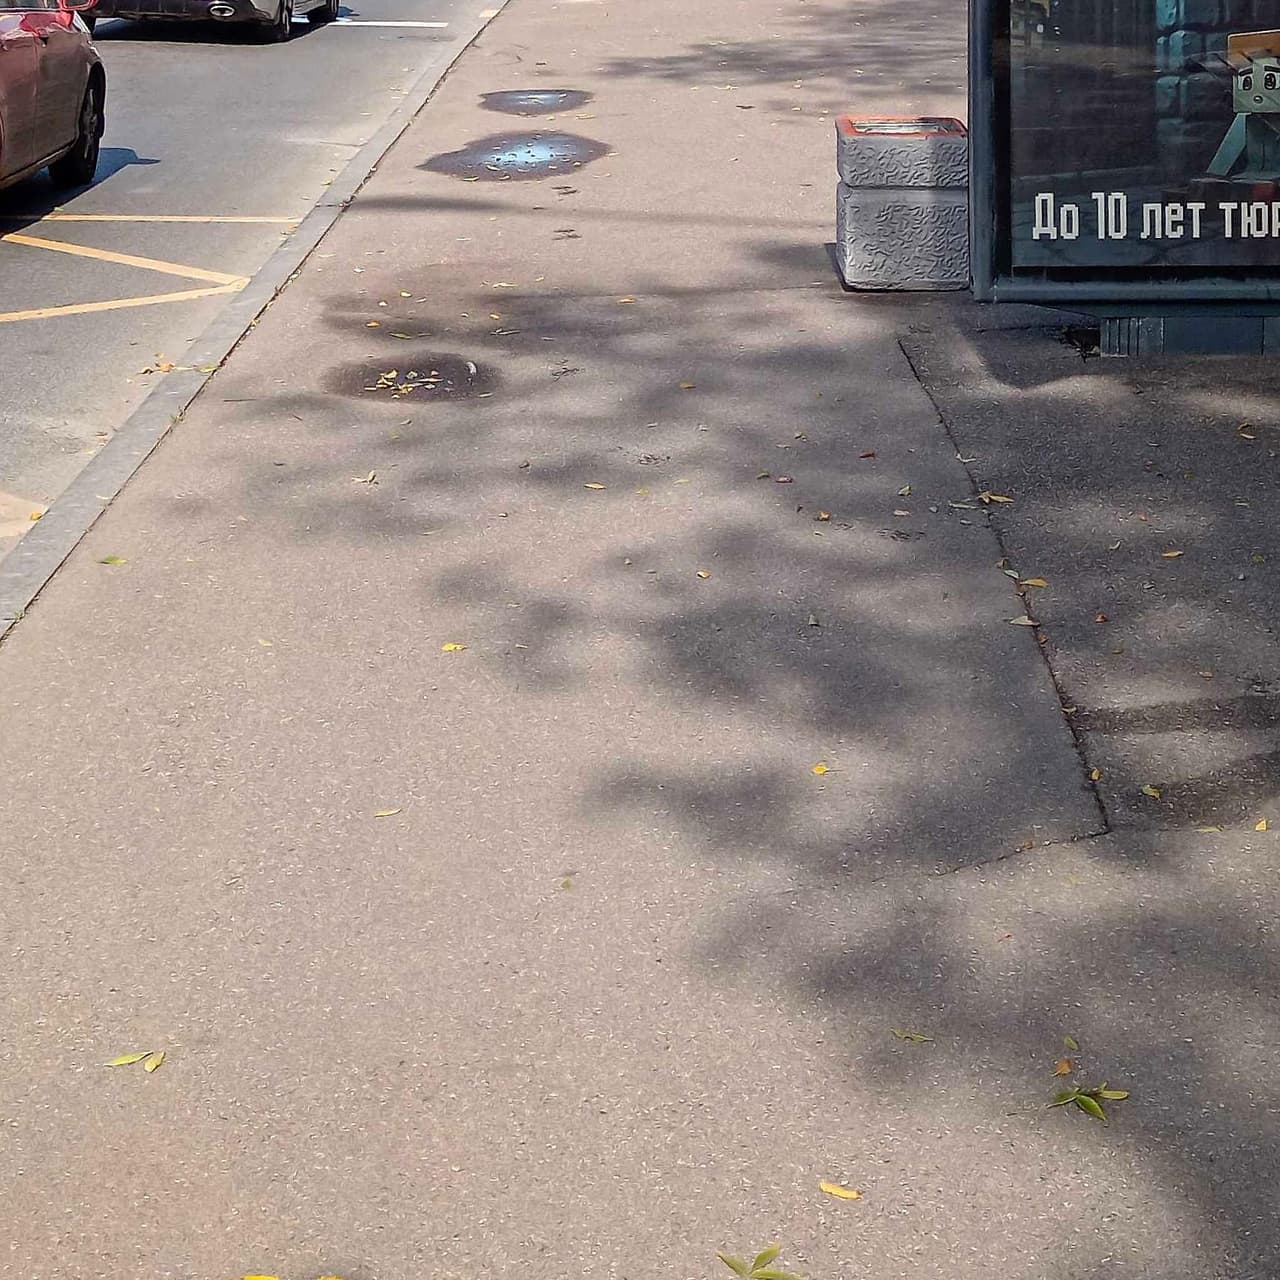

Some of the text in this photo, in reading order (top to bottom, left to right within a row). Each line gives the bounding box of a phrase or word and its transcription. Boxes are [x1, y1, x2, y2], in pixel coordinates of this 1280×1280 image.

[1031, 191, 1078, 241] До
[1091, 192, 1128, 240] 10
[1140, 198, 1207, 241] лет
